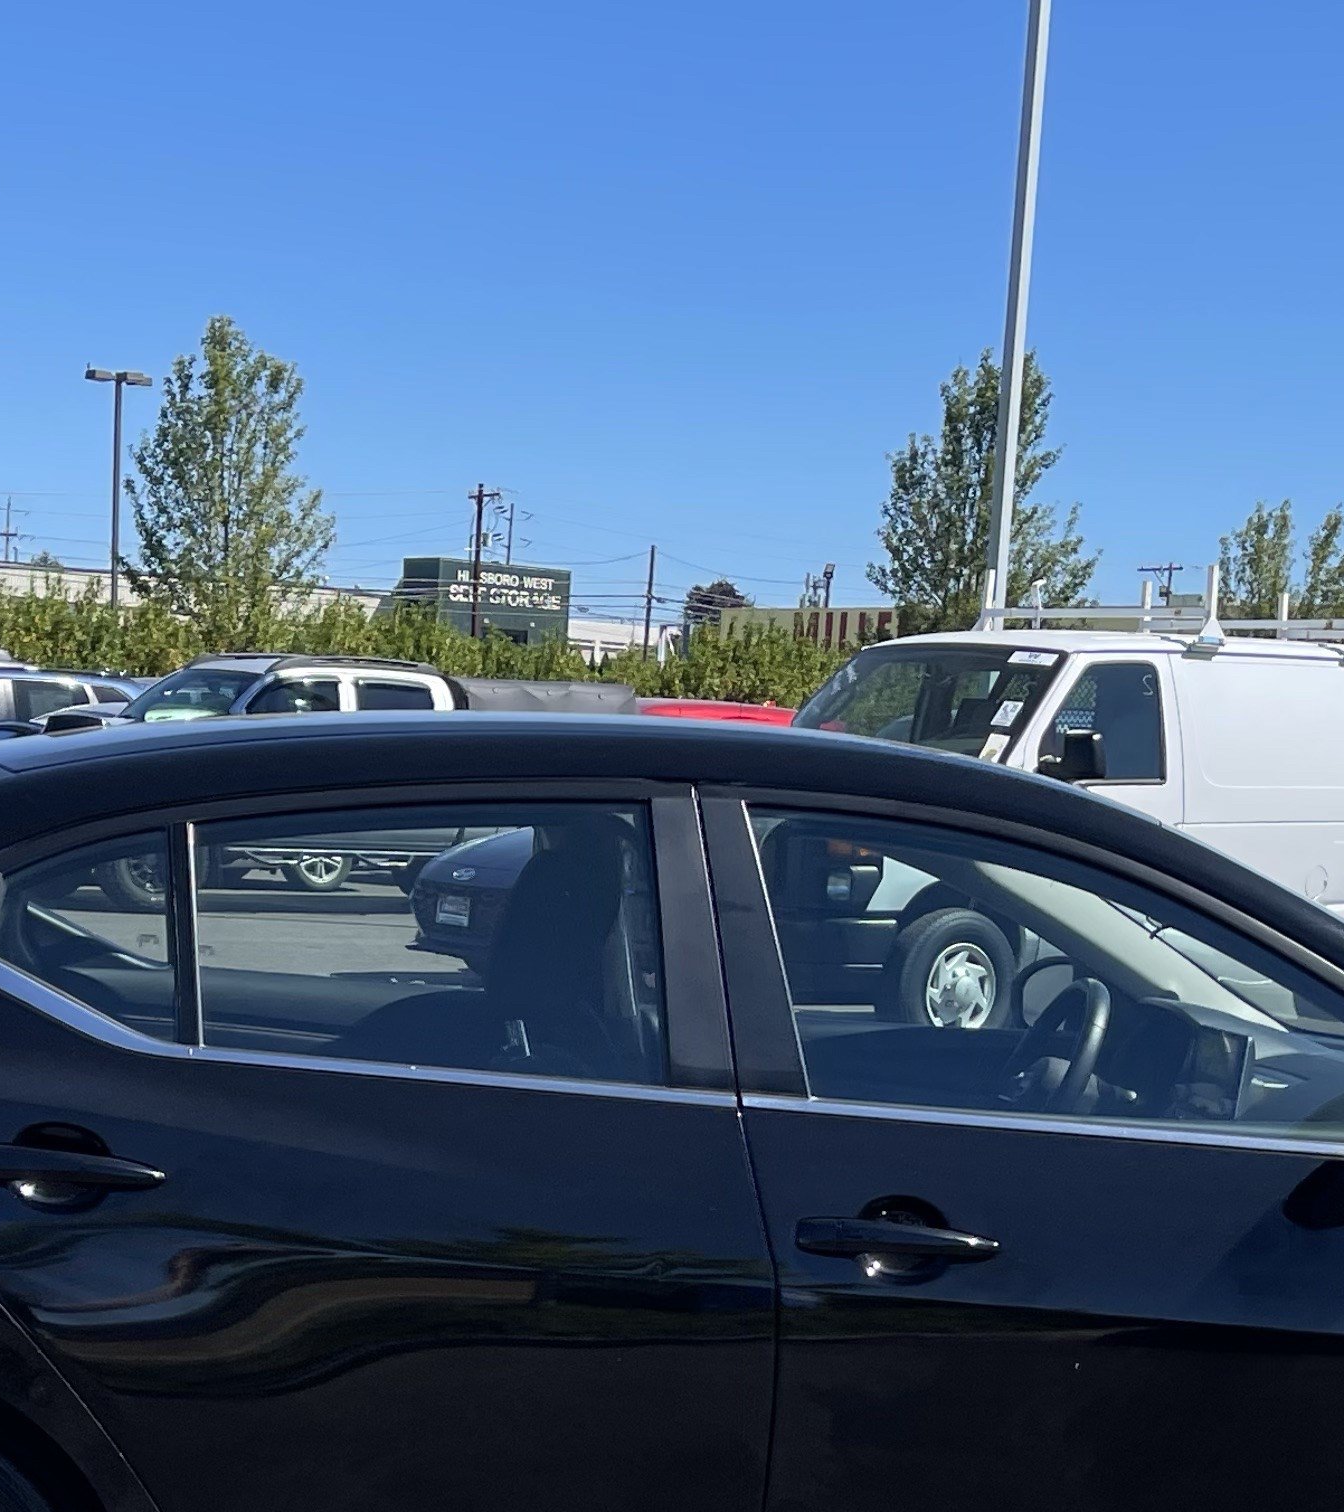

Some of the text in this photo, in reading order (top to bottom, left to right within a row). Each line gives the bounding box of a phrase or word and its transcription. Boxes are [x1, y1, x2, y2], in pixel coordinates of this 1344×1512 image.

[457, 570, 555, 591] HISBORO WEST
[449, 584, 561, 611] SELF STORAGE
